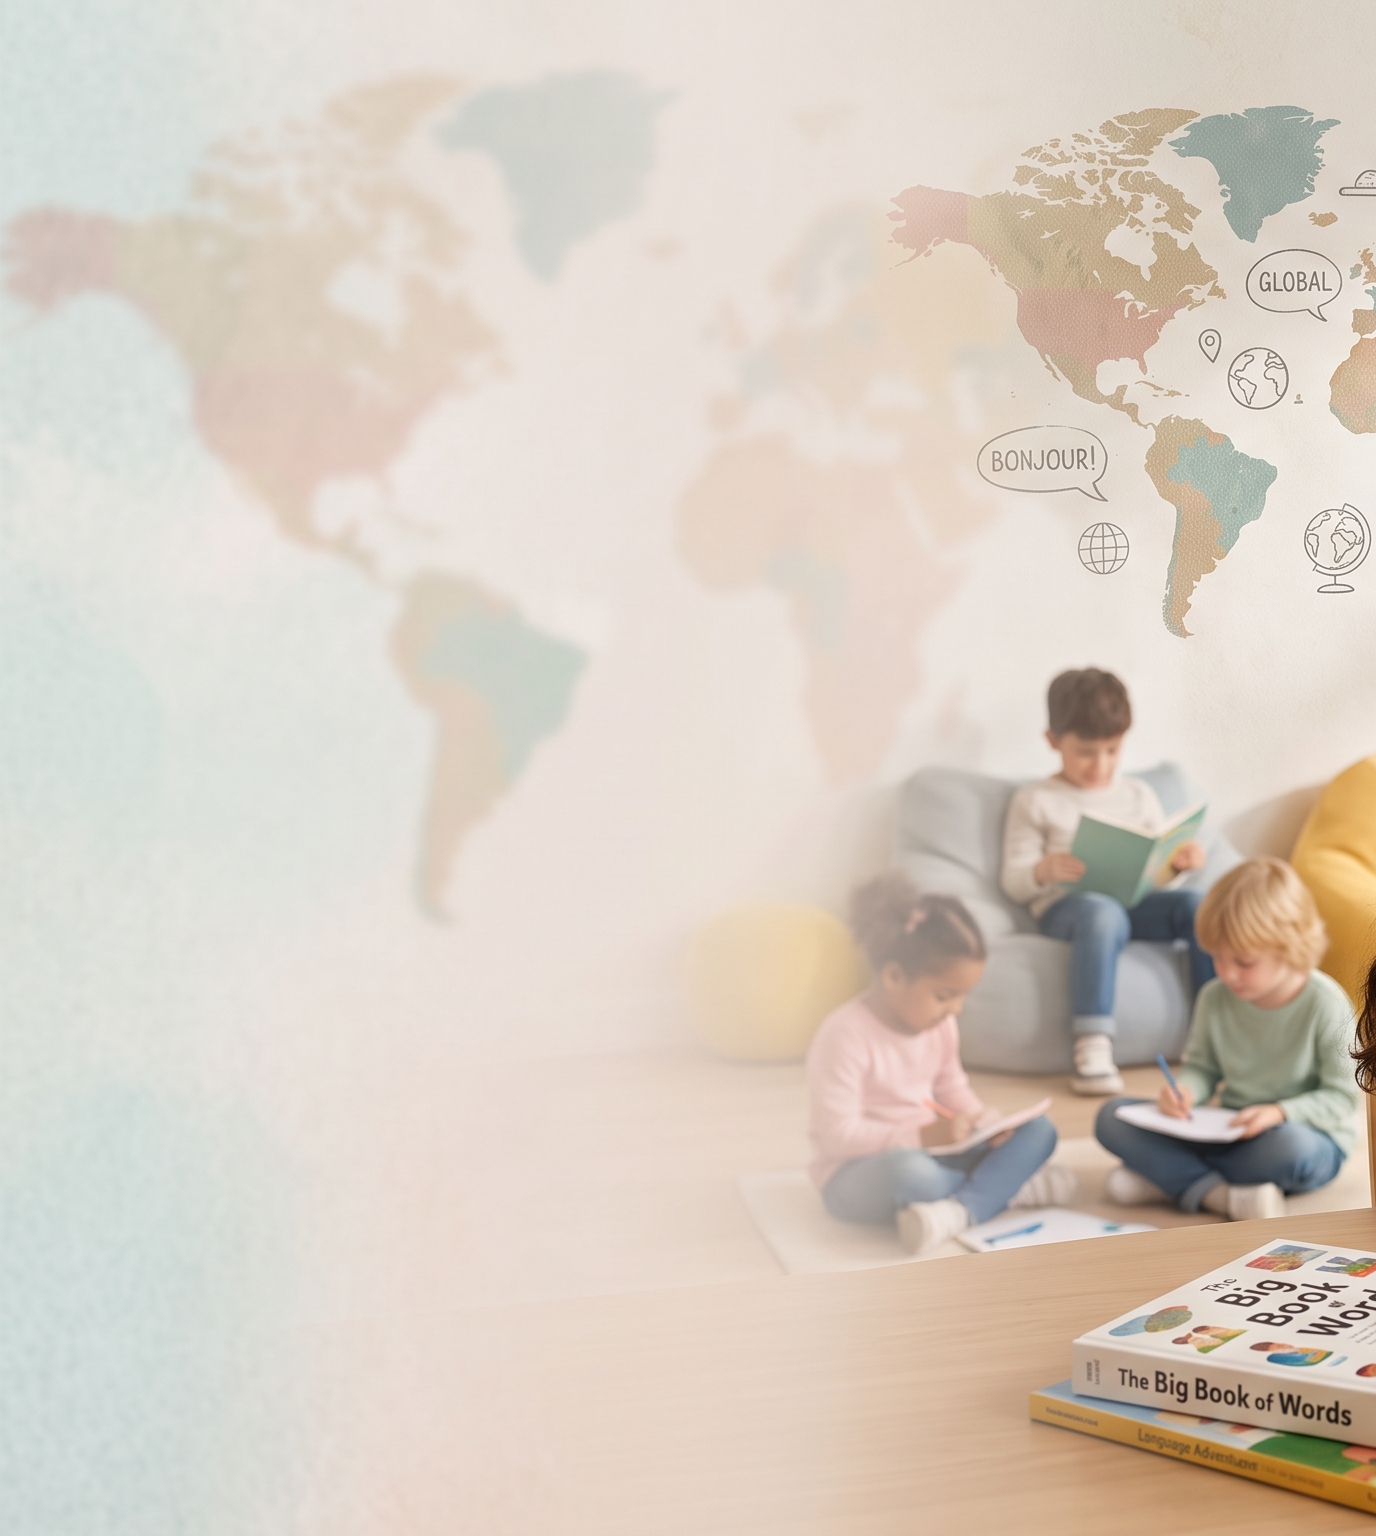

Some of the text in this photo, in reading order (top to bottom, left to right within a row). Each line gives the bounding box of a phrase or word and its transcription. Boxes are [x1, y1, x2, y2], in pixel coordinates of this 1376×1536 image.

[1259, 270, 1333, 292] GLOBAL
[991, 445, 1096, 472] BONJOUR!
[1214, 1279, 1298, 1307] Big
[1246, 1282, 1349, 1327] Book
[1118, 1367, 1150, 1390] The
[1154, 1370, 1189, 1403] Big
[1194, 1377, 1250, 1409] Book
[1254, 1393, 1275, 1412] of
[1279, 1391, 1353, 1427] Words
[1138, 1428, 1191, 1456] Language
